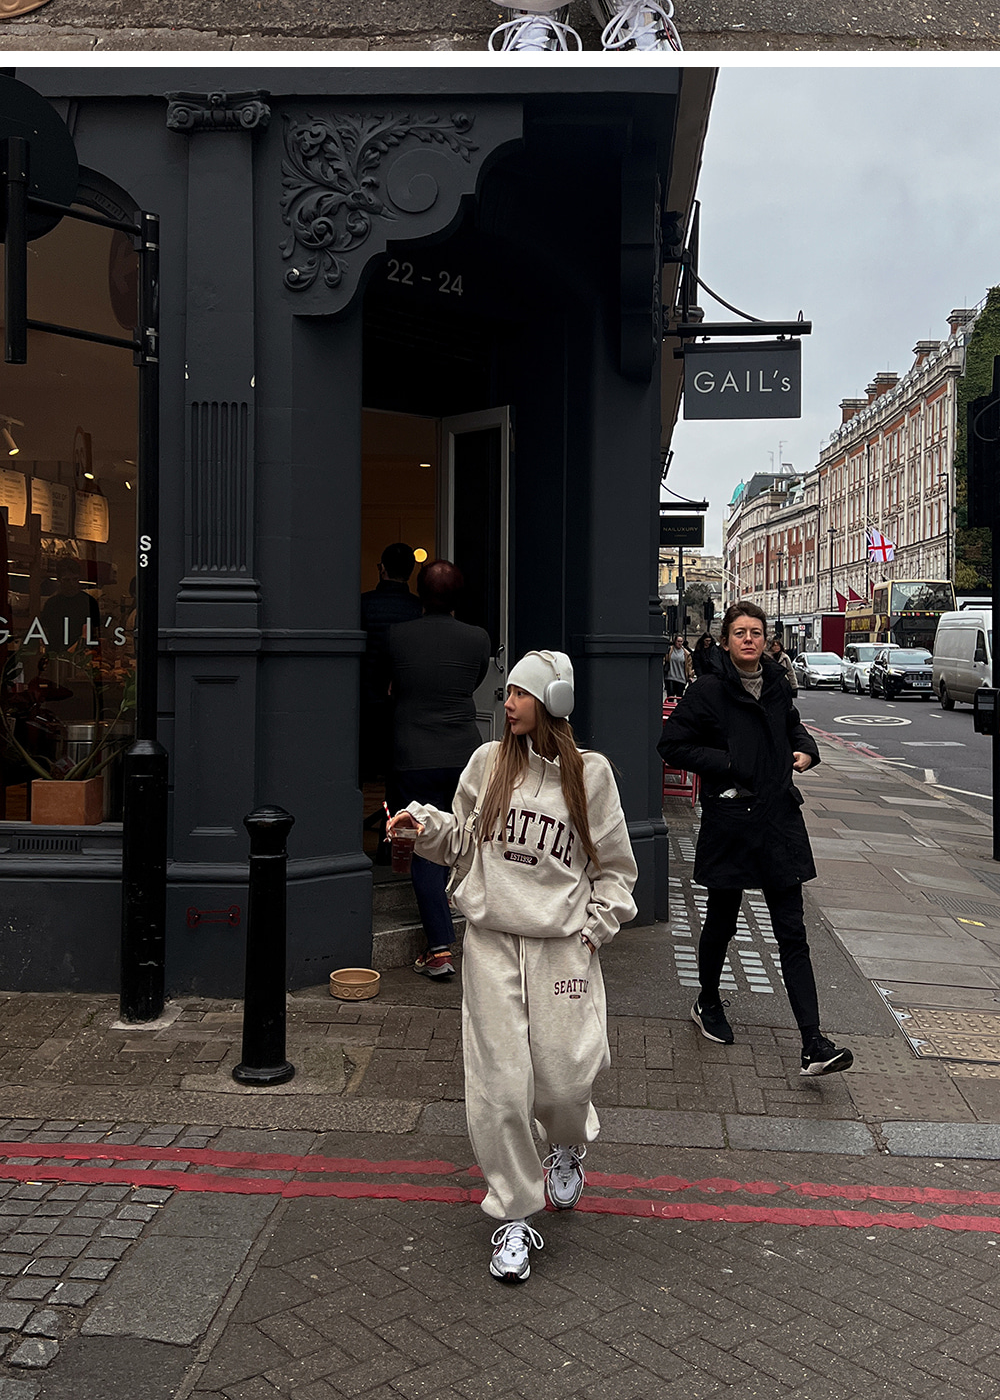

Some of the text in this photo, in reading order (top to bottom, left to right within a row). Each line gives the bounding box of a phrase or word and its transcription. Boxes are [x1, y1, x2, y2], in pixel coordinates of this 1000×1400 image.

[693, 369, 791, 394] GAIL's
[139, 534, 152, 552] S
[139, 553, 149, 568] 3
[497, 807, 576, 869] ATTLE
